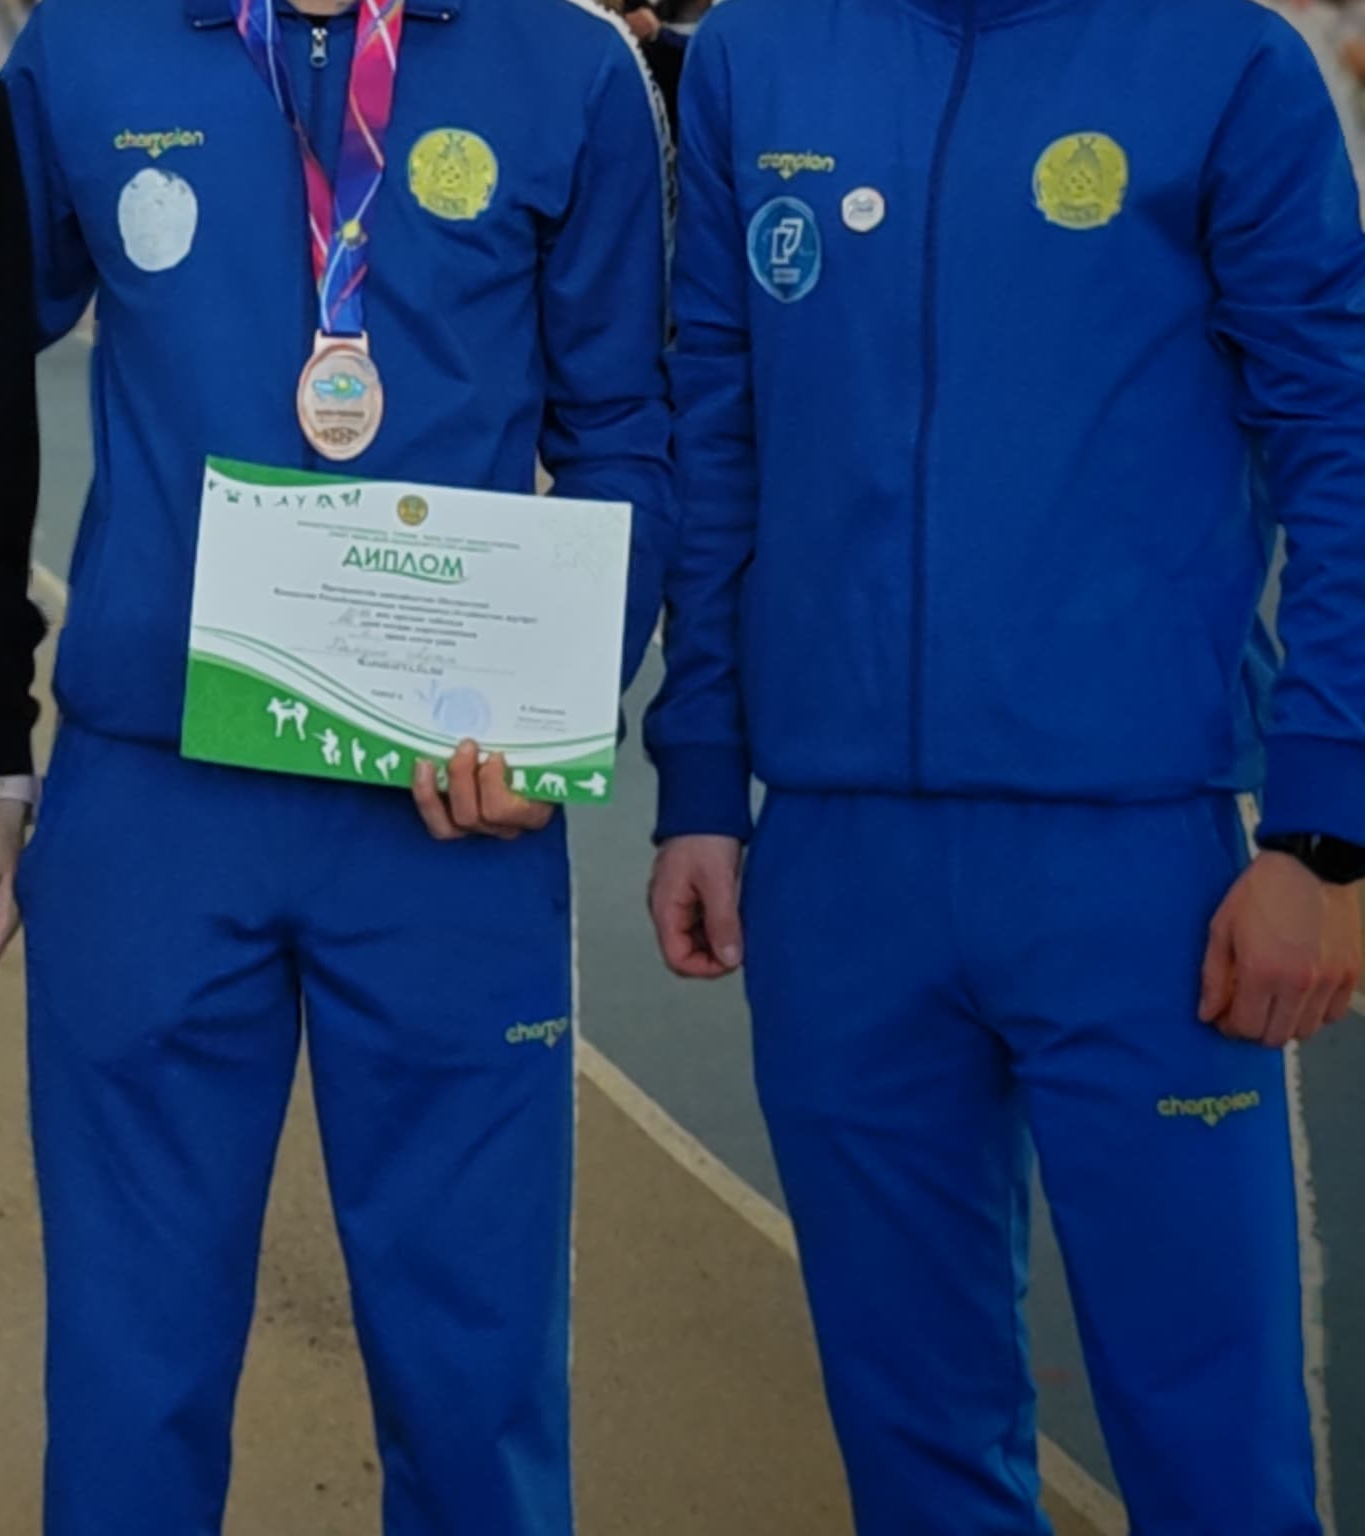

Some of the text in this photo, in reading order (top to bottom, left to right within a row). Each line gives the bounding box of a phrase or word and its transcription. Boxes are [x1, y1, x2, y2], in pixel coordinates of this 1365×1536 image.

[114, 127, 205, 159] champion
[758, 149, 835, 180] campion
[341, 544, 465, 579] ДИПЛОМ
[1156, 1090, 1260, 1127] champion
